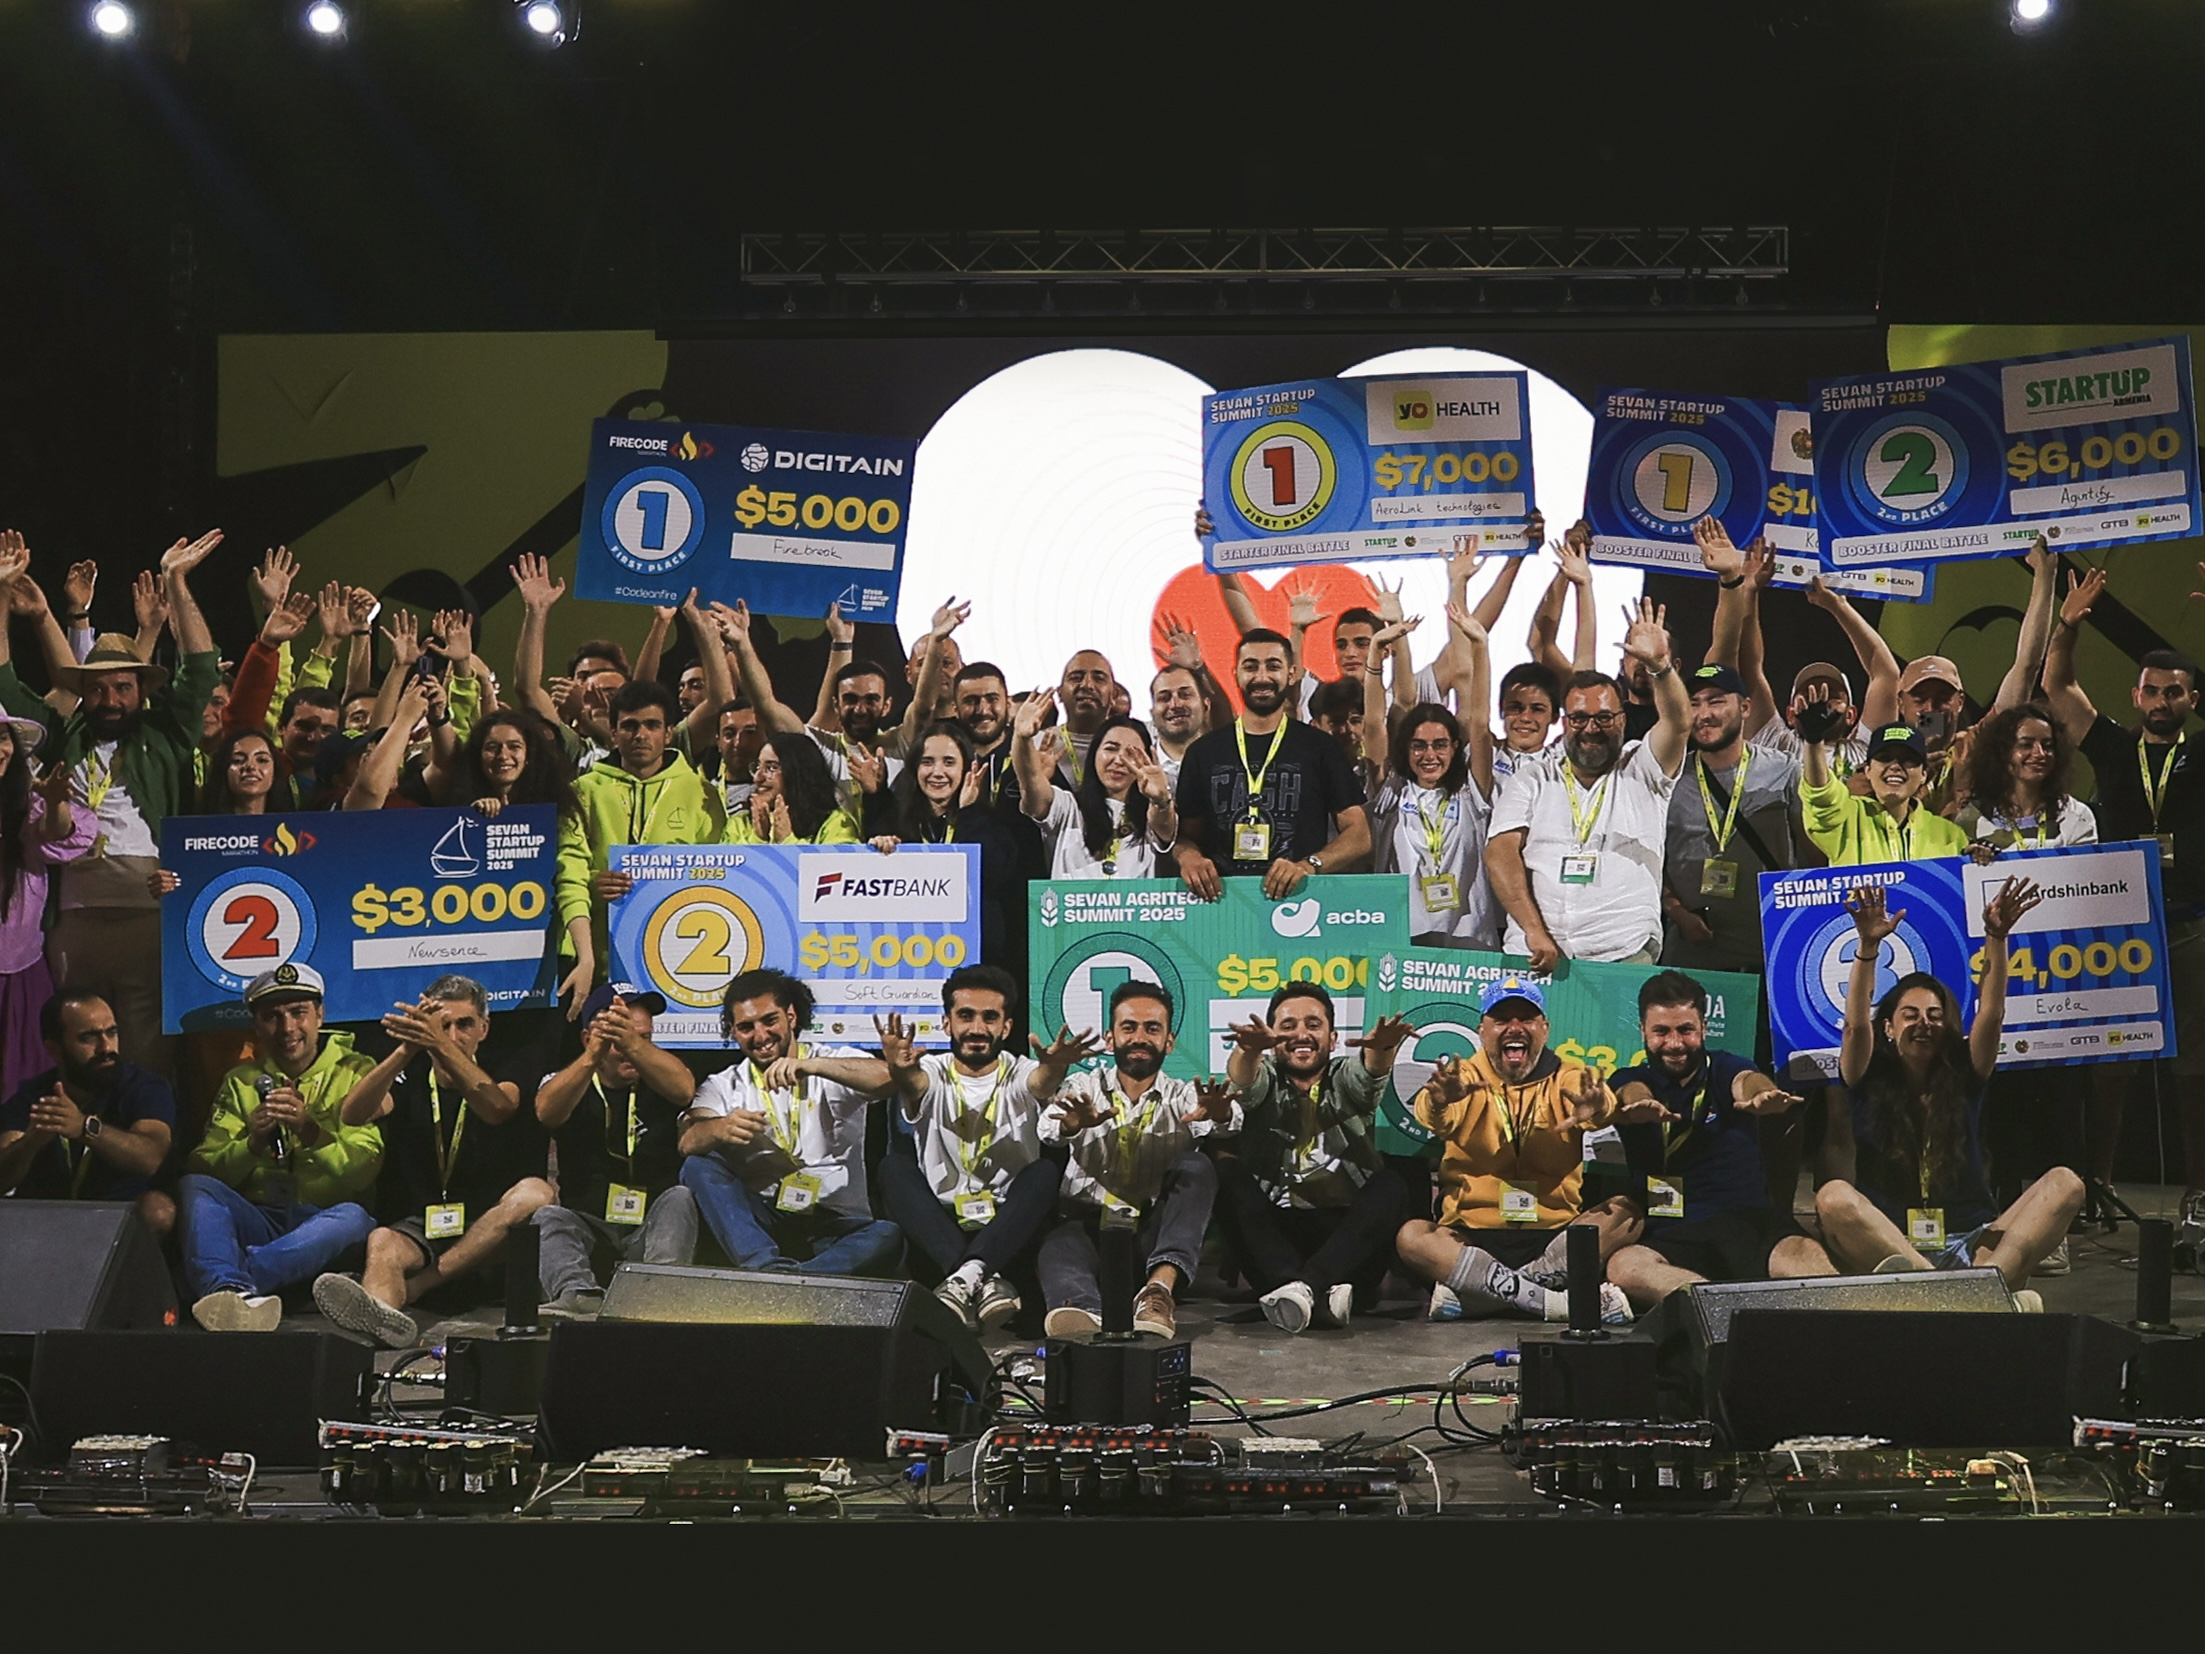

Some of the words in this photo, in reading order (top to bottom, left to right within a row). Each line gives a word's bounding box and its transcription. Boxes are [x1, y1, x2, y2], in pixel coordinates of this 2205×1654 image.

[1821, 384, 1873, 400] SEVAN
[1877, 376, 1946, 393] STARTUP
[2025, 367, 2150, 407] STARTUP
[1211, 397, 1253, 413] SEVAN
[1256, 388, 1316, 405] STARTUP
[1436, 401, 1500, 417] HEALTH
[1607, 395, 1655, 410] SEVAN
[1659, 399, 1725, 415] STARTUP
[1822, 395, 1886, 413] SUMMIT
[1890, 391, 1927, 405] 2025
[1211, 407, 1263, 424] SUMMIT
[1267, 402, 1298, 416] 2025
[1606, 407, 1665, 422] SUMMIT
[1669, 412, 1705, 425] 2025
[609, 436, 668, 451] FIRECODE
[774, 451, 903, 476] DIGITAIN
[1880, 432, 1940, 497] 2
[2007, 428, 2180, 482] $6,000
[1263, 446, 1296, 505] 1
[1374, 452, 1519, 492] $7,000
[1658, 452, 1693, 513] 1
[734, 484, 899, 534] $5,000
[1243, 507, 1278, 528] FIRST
[1284, 501, 1321, 527] PLACE
[1630, 505, 1665, 532] FIRST
[1900, 501, 1948, 522] PLACE
[637, 491, 669, 550] 1
[2002, 529, 2040, 540] STARTUP
[2101, 519, 2129, 529] GTB
[2151, 514, 2181, 523] HEALTH
[1219, 544, 1268, 561] STARTER
[1269, 542, 1305, 558] FINAL
[1306, 539, 1350, 554] BATTLE
[1364, 538, 1397, 547] STARTUP
[1496, 533, 1521, 541] HEALTH
[1838, 541, 1898, 558] BOOSTER
[1900, 537, 1940, 553] FINAL
[1941, 533, 1989, 550] BATTLE
[610, 546, 643, 573] FIRST
[647, 551, 688, 573] PLACE
[1595, 543, 1650, 559] BOOSTER
[1652, 549, 1690, 564] FINAL
[1841, 571, 1867, 580] GTB
[1887, 578, 1914, 586] HEALTH
[486, 824, 530, 836] SEVAN
[184, 835, 259, 851] FIRECODE
[486, 835, 546, 848] STARTUP
[486, 847, 540, 860] SUMMIT
[621, 854, 672, 868] SEVAN
[676, 854, 745, 868] STARTUP
[486, 860, 514, 870] 2025
[624, 867, 684, 880] SUMMIT
[688, 866, 726, 880] 2025
[842, 878, 951, 897] FASTBANK
[1773, 878, 1828, 896] SEVAN
[1831, 871, 1906, 890] STARTUP
[351, 881, 546, 934] $3,000
[1064, 893, 1121, 907] SEVAN
[1125, 892, 1209, 906] AGRITEC
[1774, 891, 1842, 909] SUMMIT
[1064, 908, 1136, 923] SUMMIT
[1139, 907, 1186, 922] 2025
[1326, 909, 1386, 924] acba
[222, 895, 280, 960] 2
[675, 909, 732, 975] 2
[799, 930, 966, 974] $5,000
[1402, 959, 1462, 978] SEVAN
[1401, 976, 1473, 995] SUMMIT
[2070, 1035, 2100, 1045] GTB
[2122, 1032, 2154, 1041] HEALTH
